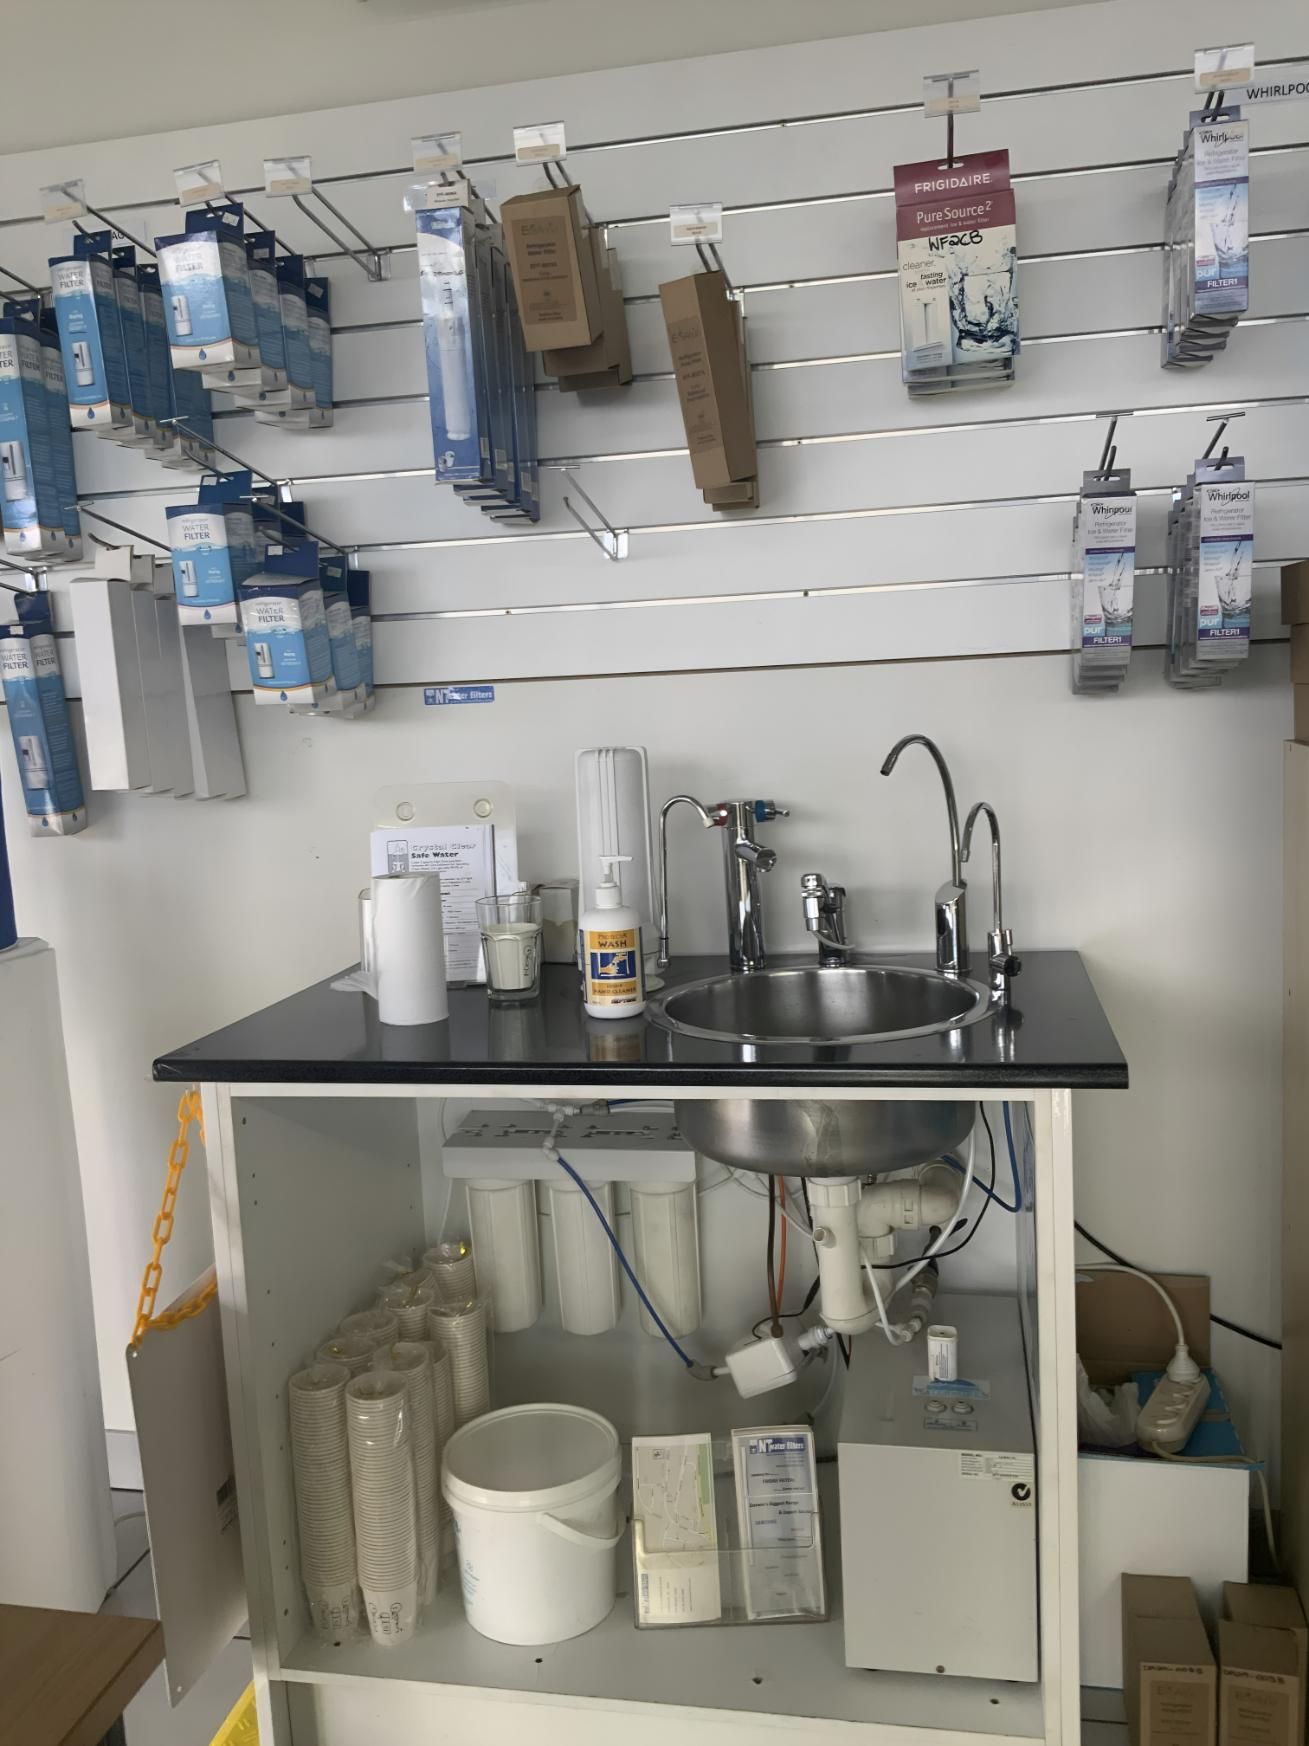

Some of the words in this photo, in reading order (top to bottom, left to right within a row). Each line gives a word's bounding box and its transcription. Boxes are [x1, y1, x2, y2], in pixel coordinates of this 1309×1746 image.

[915, 173, 991, 193] FRIGIDAIRE
[1208, 490, 1250, 502] Whirlpool
[183, 524, 209, 532] WATER
[184, 532, 210, 541] FILTER
[256, 607, 285, 616] WATER
[258, 615, 286, 624] FILTER
[1210, 628, 1240, 637] FILTER1
[1093, 636, 1122, 644] FILTER1
[3, 661, 29, 670] FILTER
[598, 941, 627, 949] WASH
